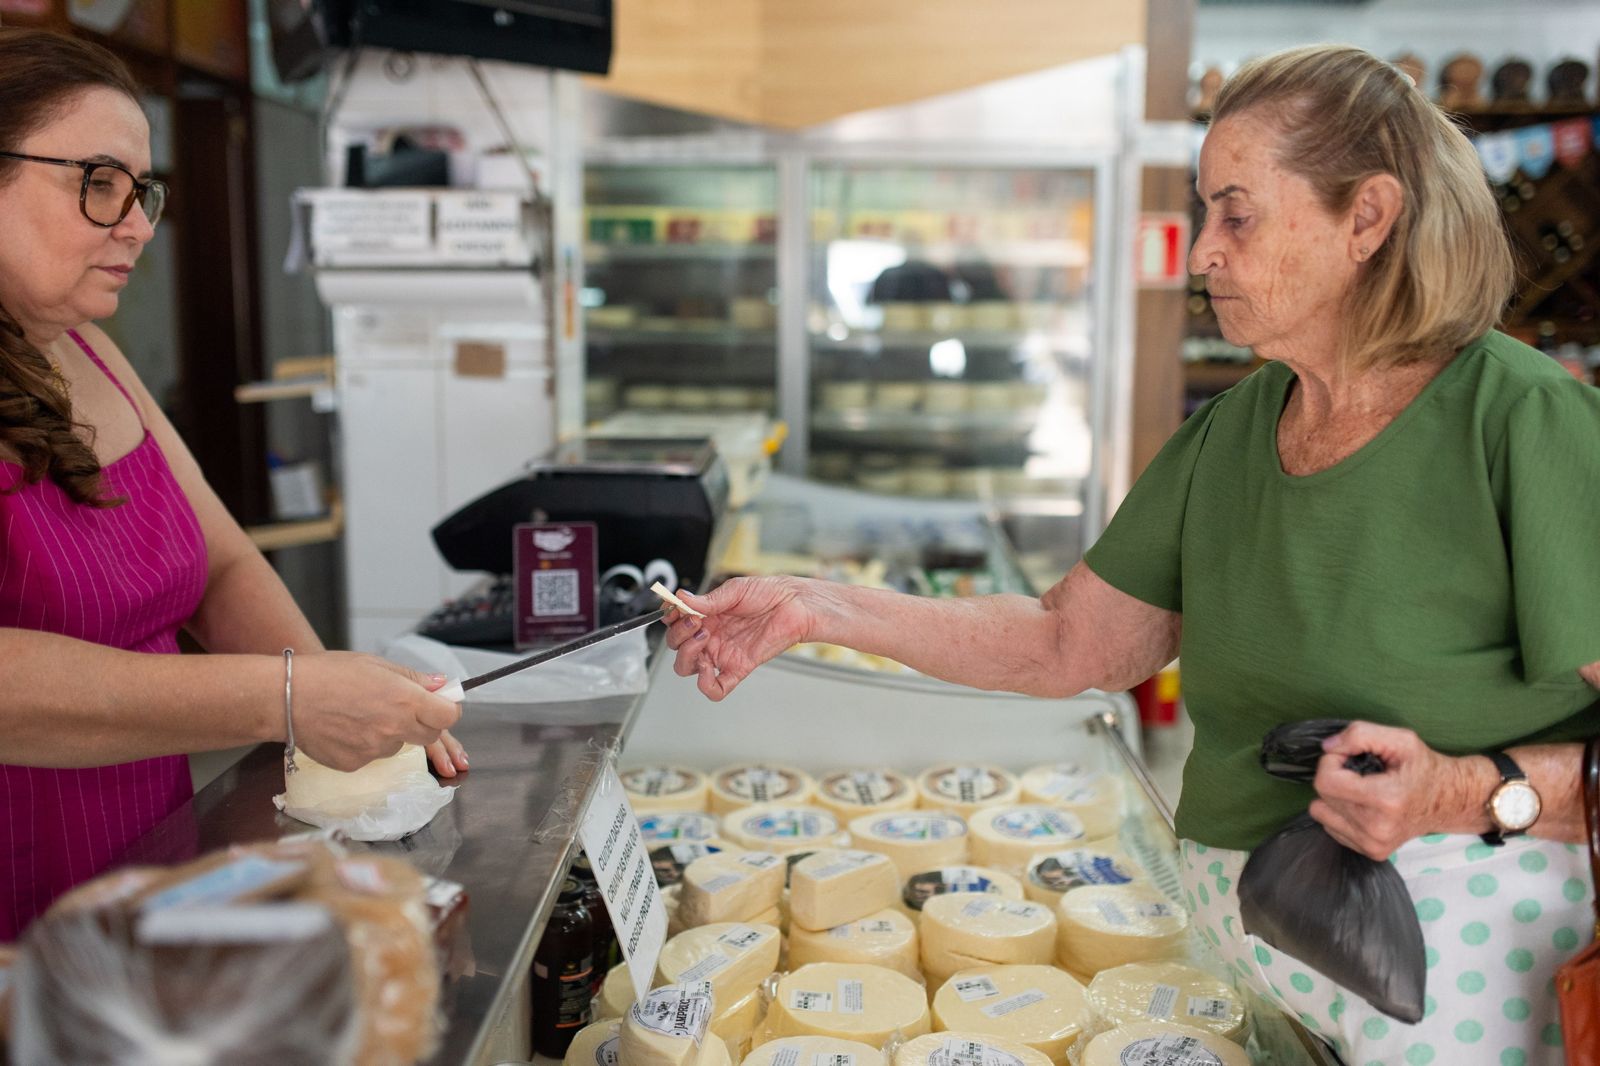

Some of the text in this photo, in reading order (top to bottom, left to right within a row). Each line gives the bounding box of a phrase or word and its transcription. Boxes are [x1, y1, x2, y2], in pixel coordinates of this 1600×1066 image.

[598, 802, 627, 872] CUIDEM DAS SUAS
[607, 824, 639, 906] CRIANÇAS PARA QUE
[620, 856, 646, 924] NÃO ESTRAGUEM
[627, 876, 656, 959] NOSSOS PRODUTOS
[674, 998, 691, 1030] JAMPRUC
